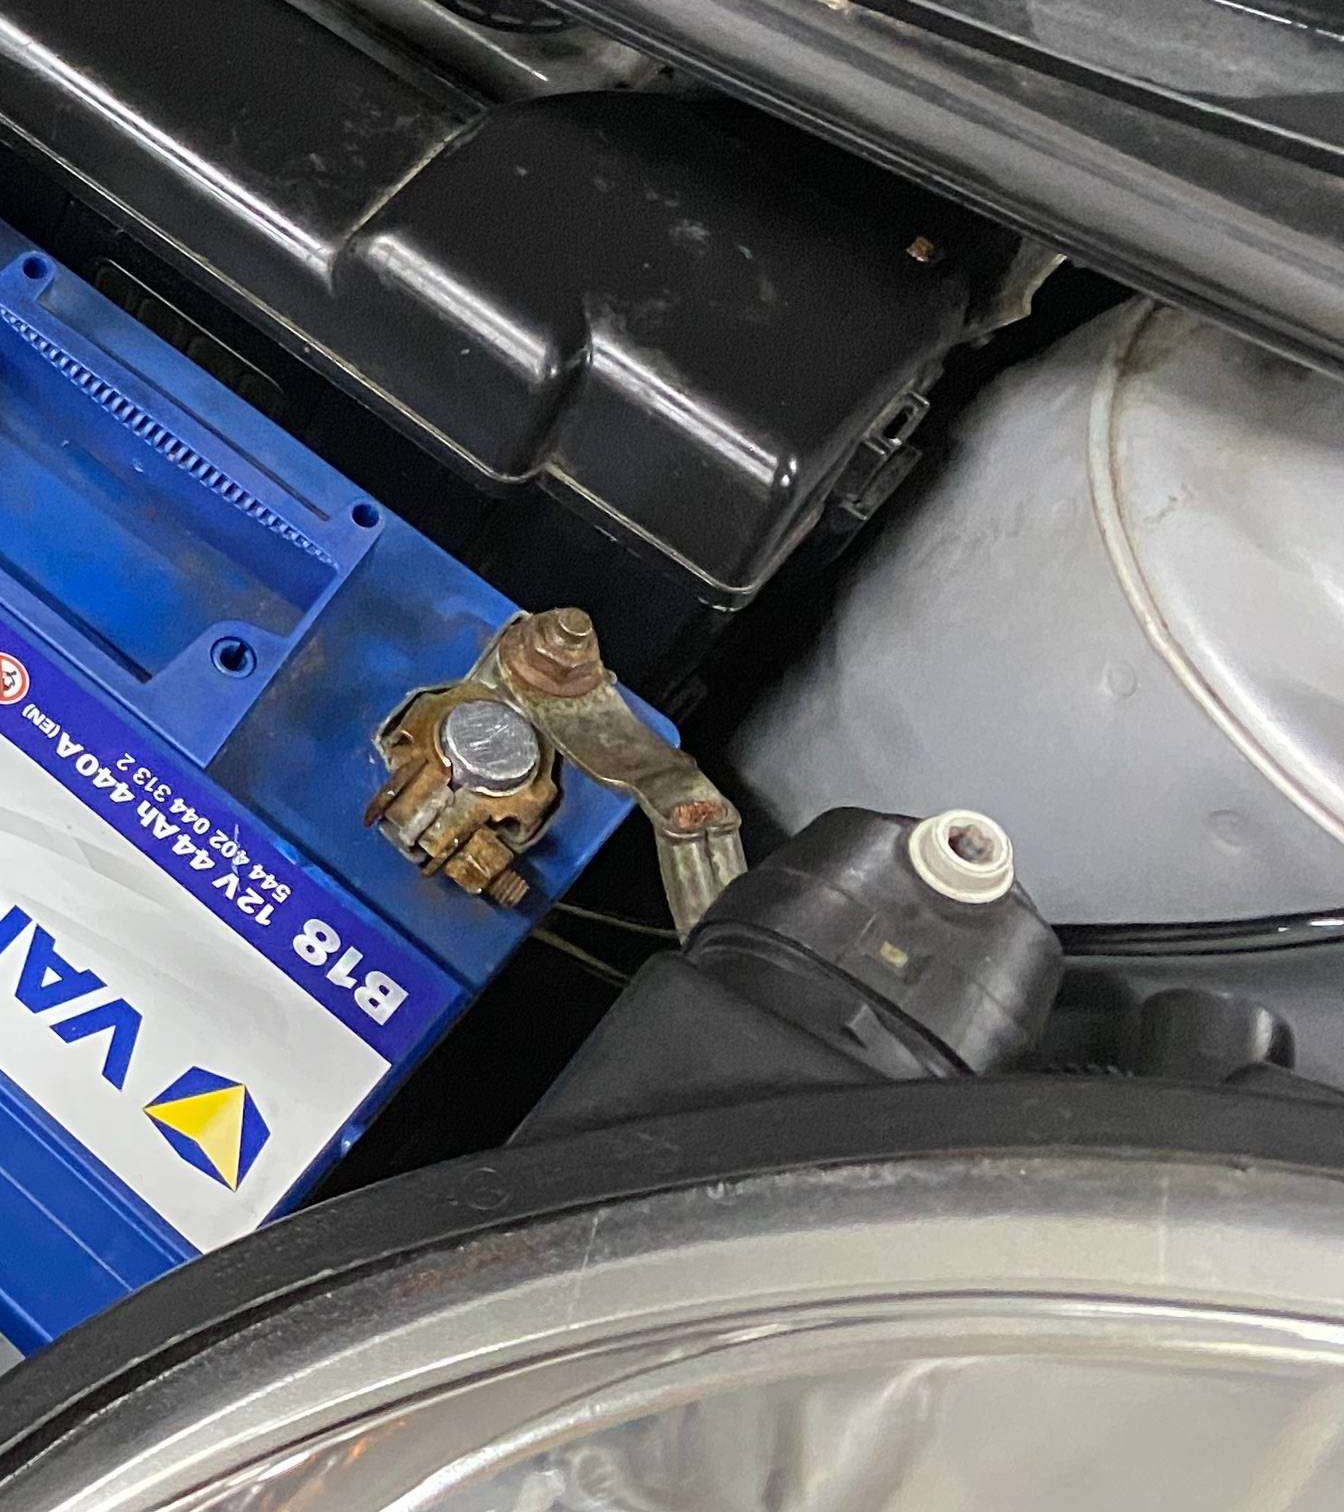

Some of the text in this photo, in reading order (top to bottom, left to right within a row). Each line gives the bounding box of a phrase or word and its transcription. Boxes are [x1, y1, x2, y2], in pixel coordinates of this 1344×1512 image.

[115, 752, 293, 904] 544 402 044 313 2
[136, 798, 216, 872] 44Ah
[211, 870, 276, 928] 12V
[291, 917, 410, 1026] B18
